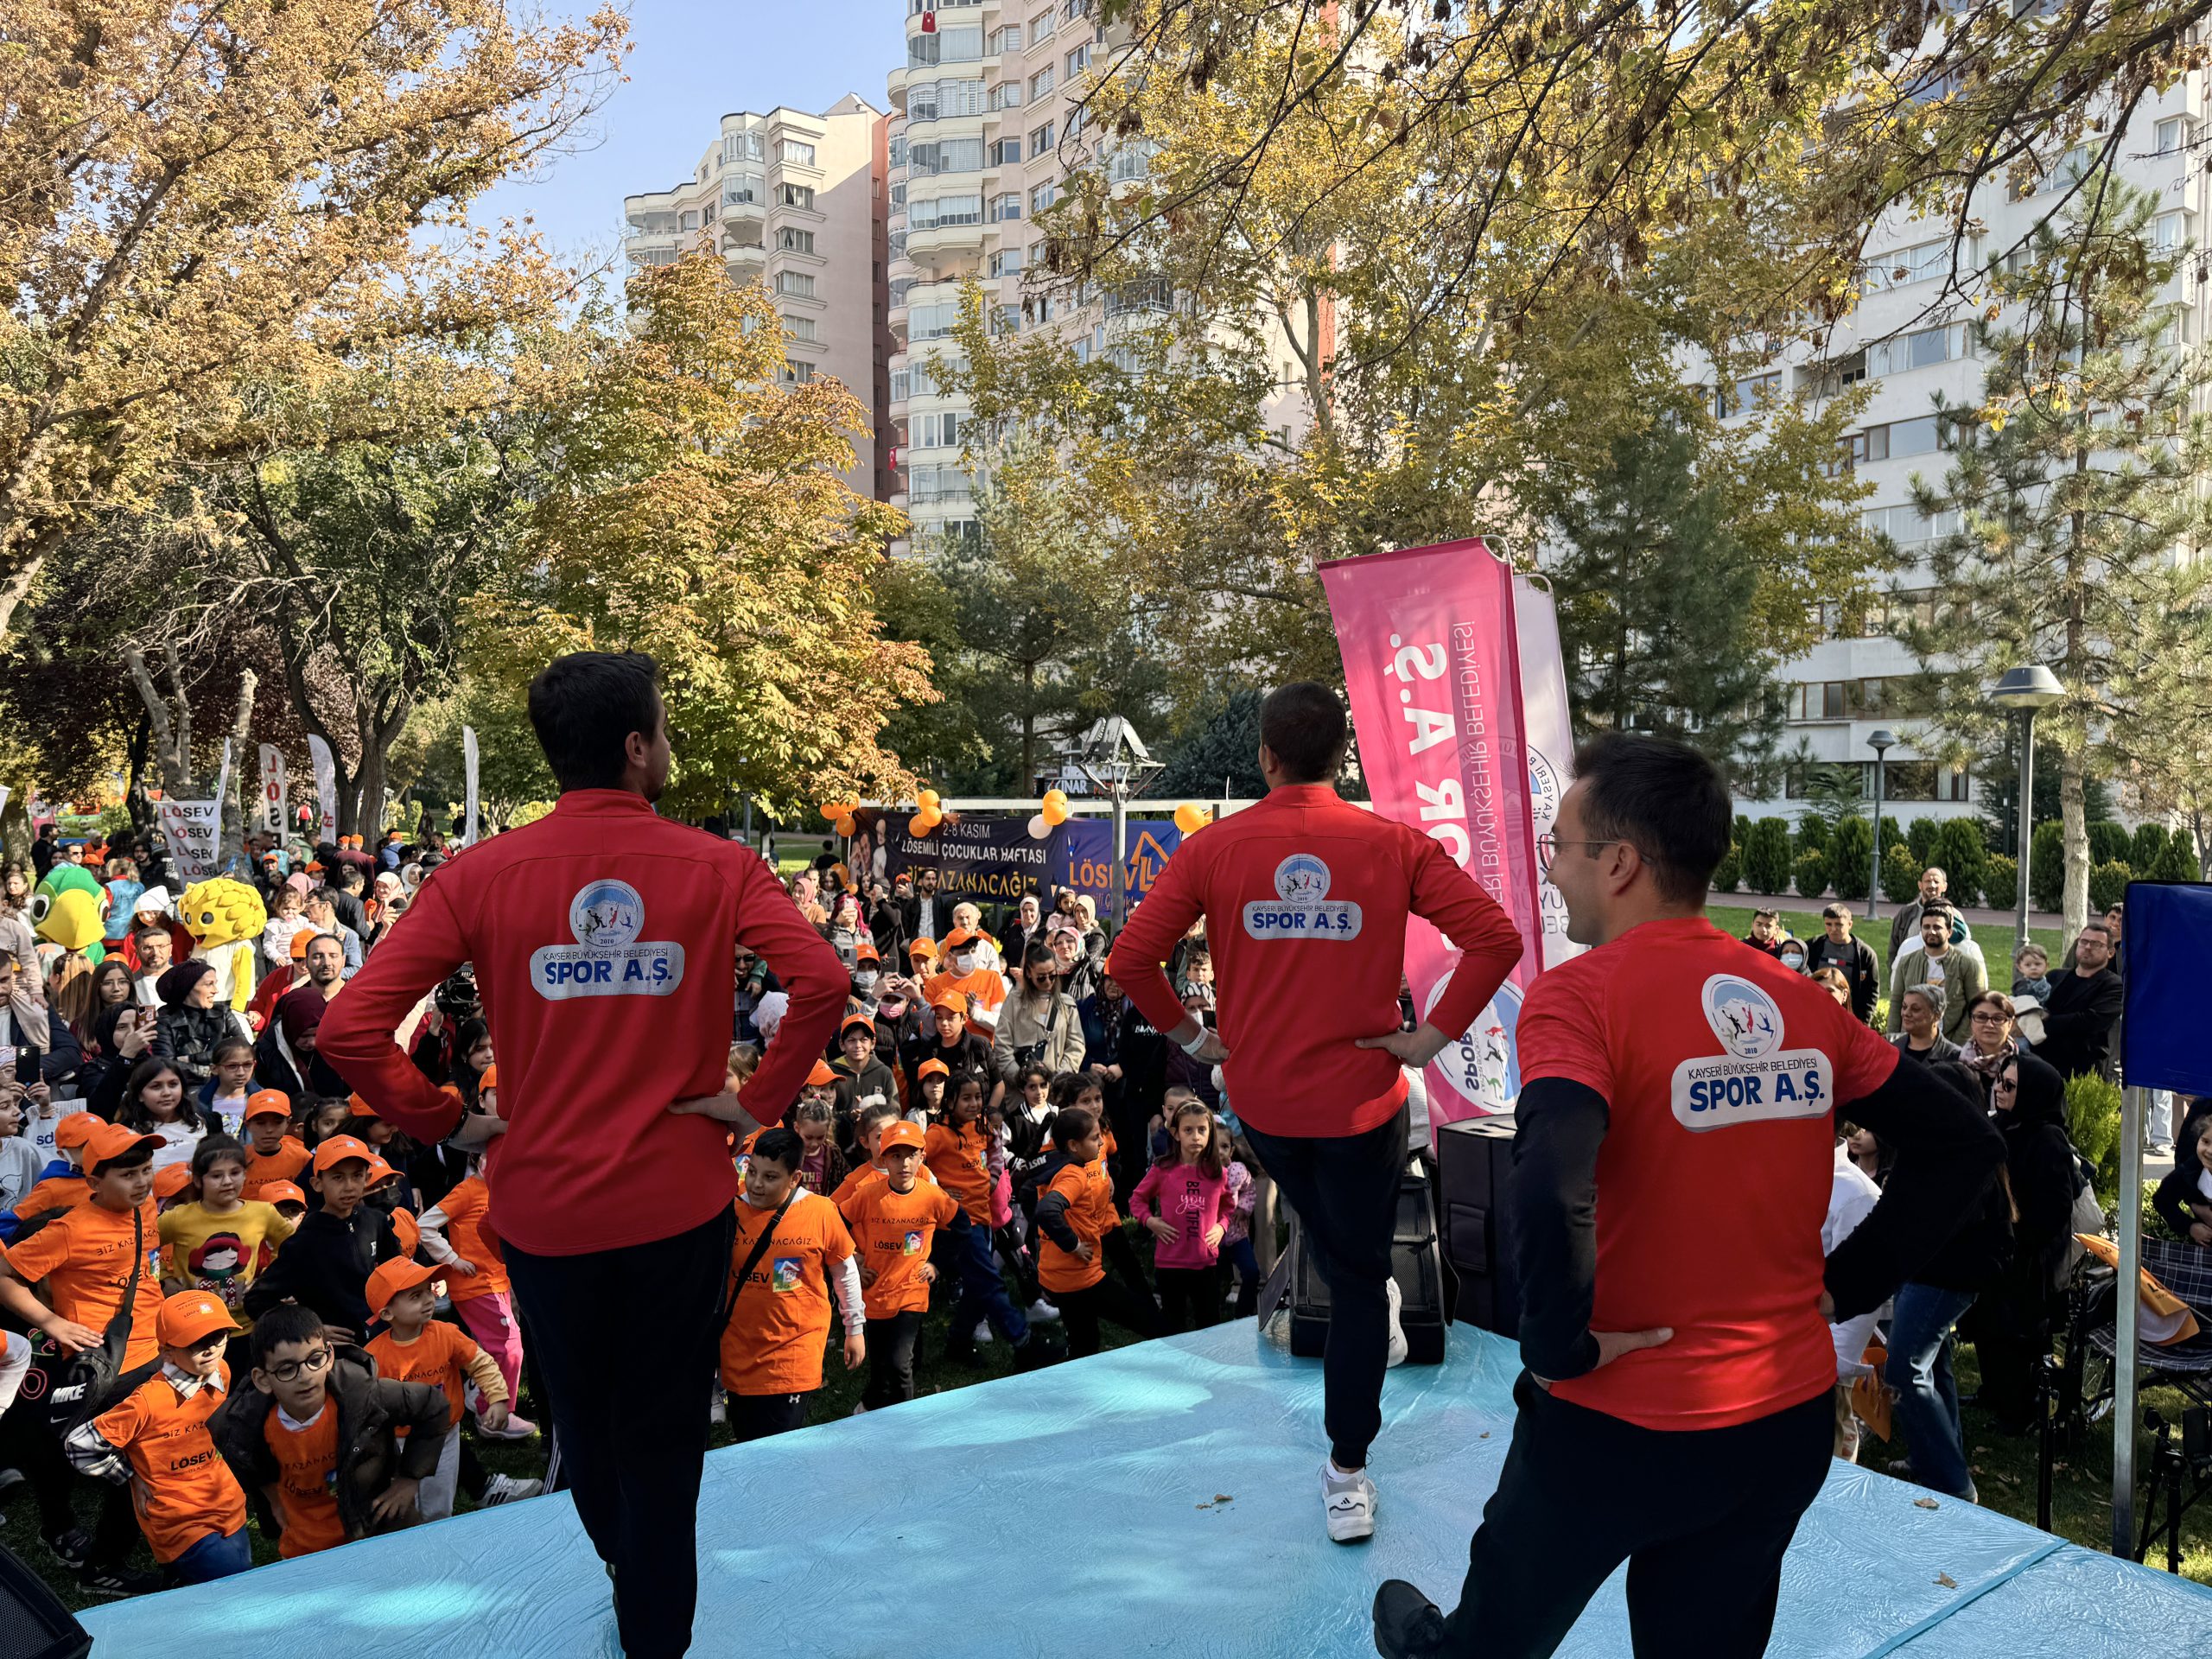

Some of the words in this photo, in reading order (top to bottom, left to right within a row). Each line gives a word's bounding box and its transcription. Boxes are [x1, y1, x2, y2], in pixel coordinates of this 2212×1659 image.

[162, 805, 214, 817] LÖSEV
[172, 826, 213, 839] ÖSEV
[943, 823, 958, 837] 2-8
[960, 823, 990, 839] KASIM
[176, 846, 213, 859] LSEV
[901, 837, 939, 856] LÖSEMİLİ
[942, 843, 998, 861] ÇOCUKLAR
[1001, 847, 1046, 864] HAFTASI
[937, 870, 1038, 898] AZANACAĞI
[1253, 912, 1306, 929] SPOR
[1314, 912, 1352, 933] A.Ş.
[572, 949, 622, 960] BÜYÜKŞEHİR
[624, 948, 668, 958] BELEDİYESİ
[544, 960, 613, 985] SPOR
[623, 957, 673, 986] A.Ş.
[1688, 1064, 1722, 1080] KAYSERİ
[1723, 1060, 1769, 1076] BÜYÜKŞEHİR
[1770, 1057, 1818, 1071] BELEDİYESİ
[1689, 1075, 1763, 1112] SPOR
[1775, 1071, 1825, 1107] A.Ş.
[1175, 1194, 1205, 1215] you
[743, 1236, 811, 1245] KANACAĞIZ
[874, 1240, 902, 1250] LÖSEV
[49, 1382, 87, 1404] NIKE
[170, 1448, 213, 1471] LÖSEV
